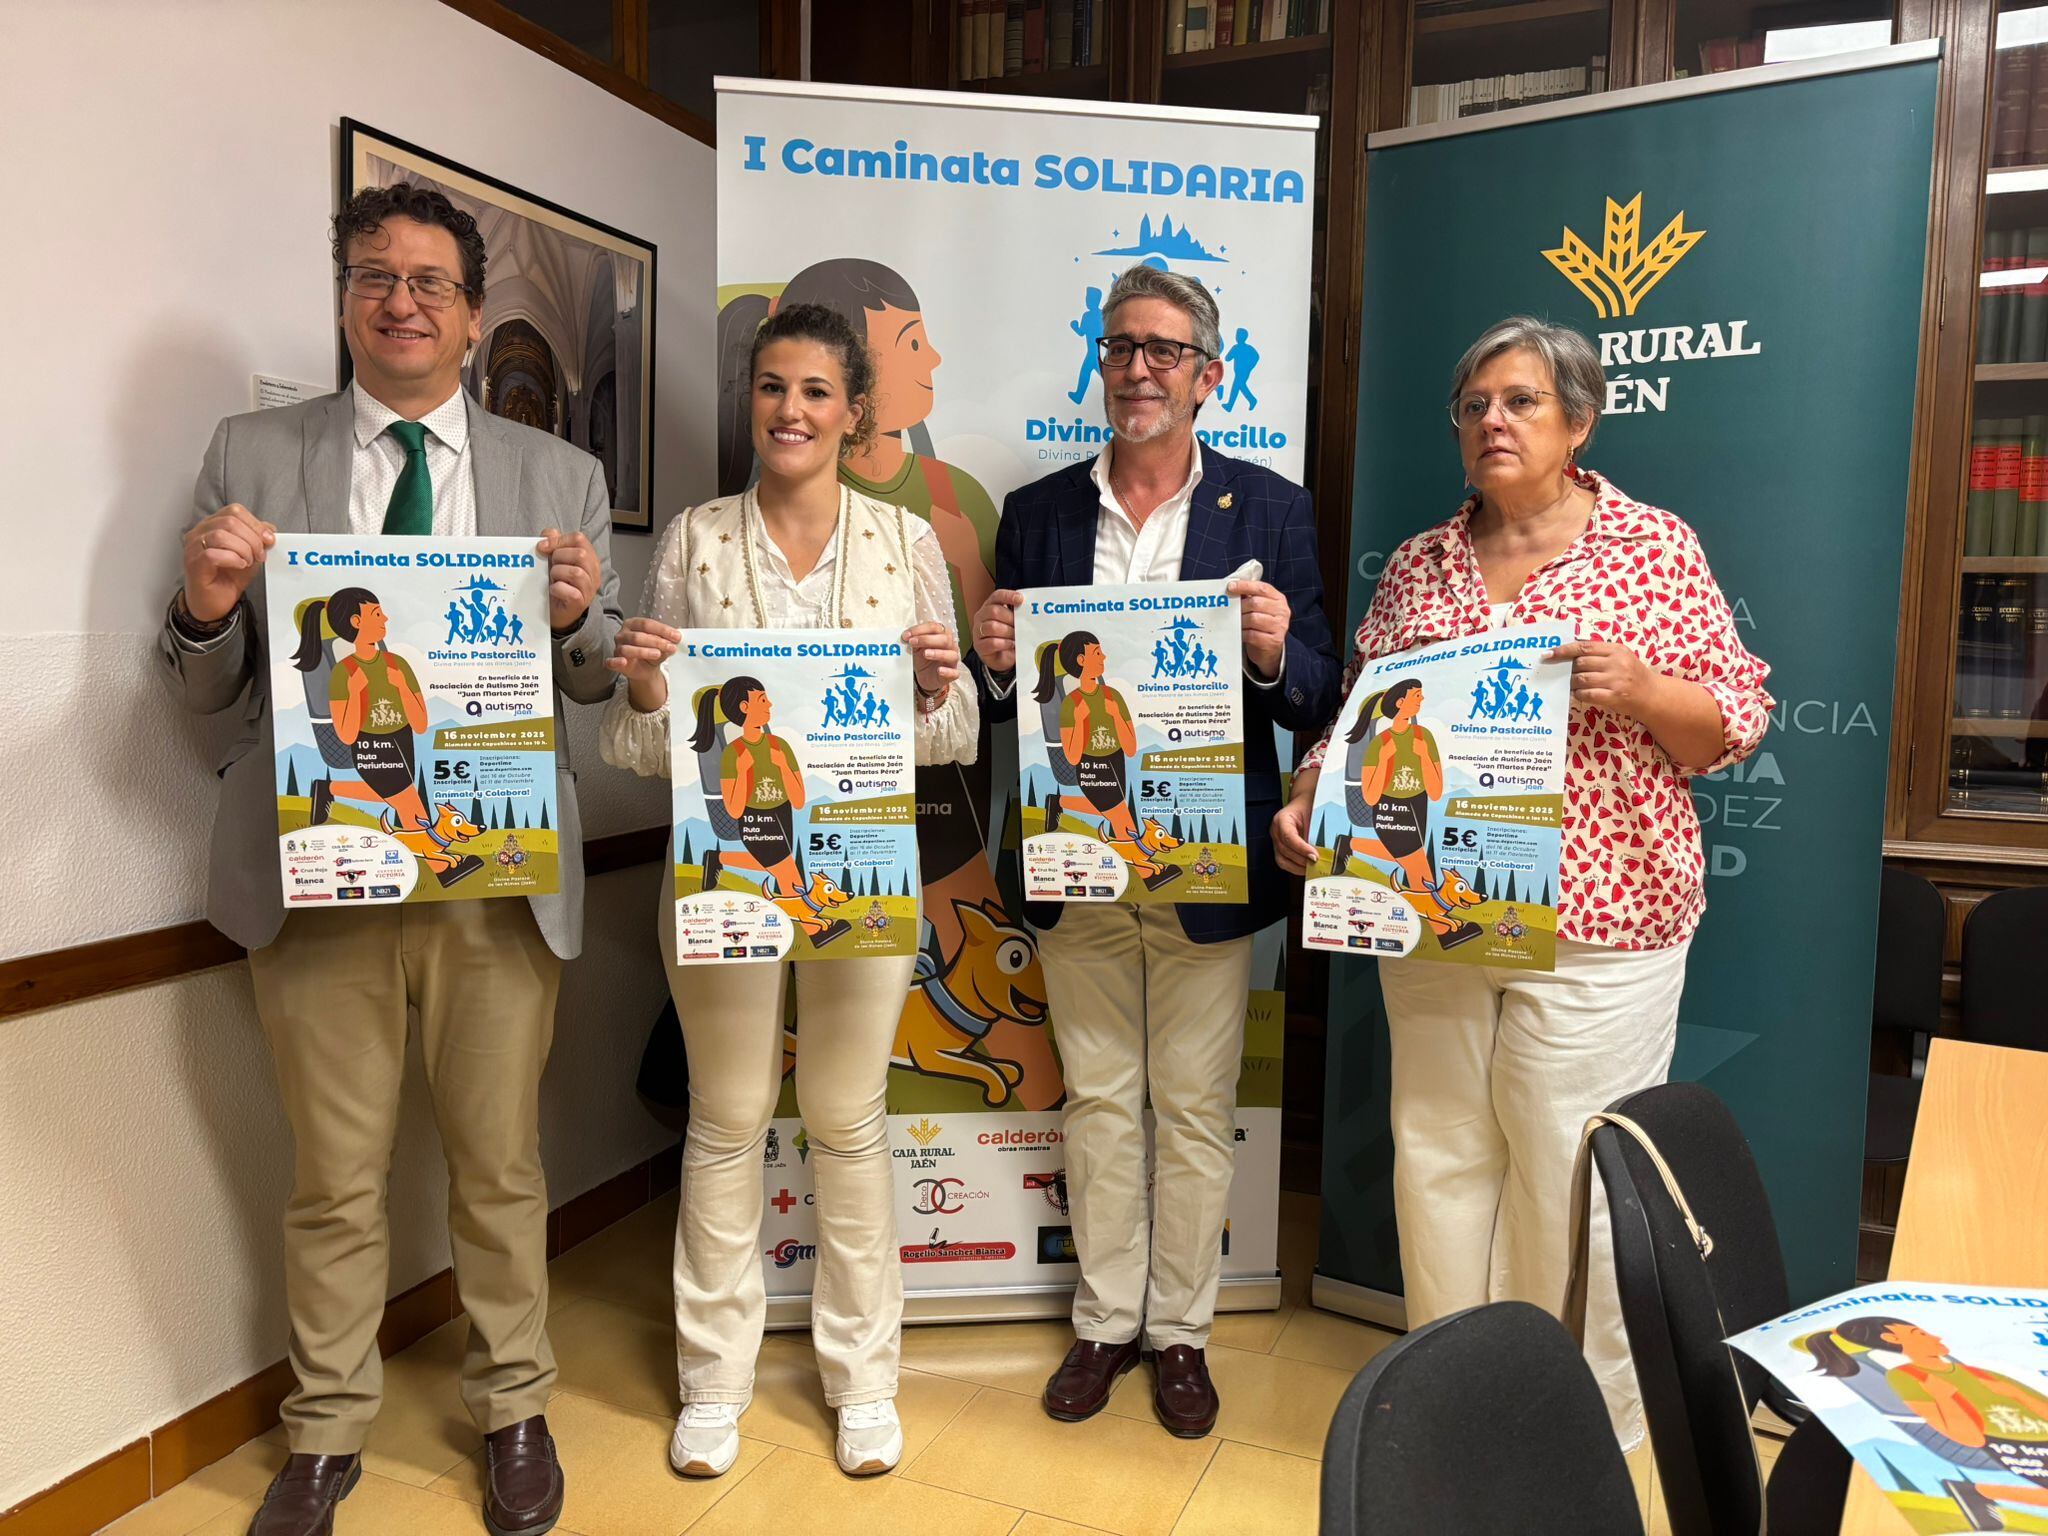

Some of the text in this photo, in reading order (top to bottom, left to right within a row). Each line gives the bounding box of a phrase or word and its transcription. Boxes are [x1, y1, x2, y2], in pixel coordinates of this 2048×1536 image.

[744, 136, 1305, 204] I Caminata SOLIDARIA
[1598, 320, 1761, 366] RURAL
[288, 550, 535, 568] I Caminata SOLIDARIA
[1031, 594, 1229, 614] I Caminata SOLIDARIA
[428, 650, 536, 659] Divino Pastorcillo
[688, 642, 901, 657] I Caminata SOLIDARIA
[1374, 636, 1561, 674] I Caminata SOLIDARIA
[1138, 682, 1228, 691] Divino Pastorcillo
[485, 702, 533, 710] autismo
[1451, 724, 1552, 735] Divino Pastorcillo
[444, 731, 457, 740] 16
[807, 732, 901, 741] Divino Pastorcillo
[357, 740, 394, 749] 10 km.
[357, 762, 404, 770] Periurbana
[434, 760, 470, 780] 5€
[1498, 776, 1544, 785] autismo
[1141, 780, 1171, 797] 5€
[435, 790, 474, 798] Anímate
[1391, 802, 1410, 812] km.
[1456, 800, 1468, 808] 16
[1471, 803, 1525, 812] noviembre
[757, 814, 775, 823] km.
[1376, 823, 1416, 832] Periurbana
[809, 833, 841, 851] 5€
[1442, 827, 1477, 848] 5€
[1442, 858, 1479, 866] Anímate
[1490, 861, 1533, 870] Colabora!
[892, 1148, 955, 1157] CAJA RURAL
[911, 1159, 936, 1169] JAÉN
[903, 1250, 936, 1258] Rogelio
[1780, 1292, 1936, 1324] Caminata
[1989, 1443, 2017, 1455] 10
